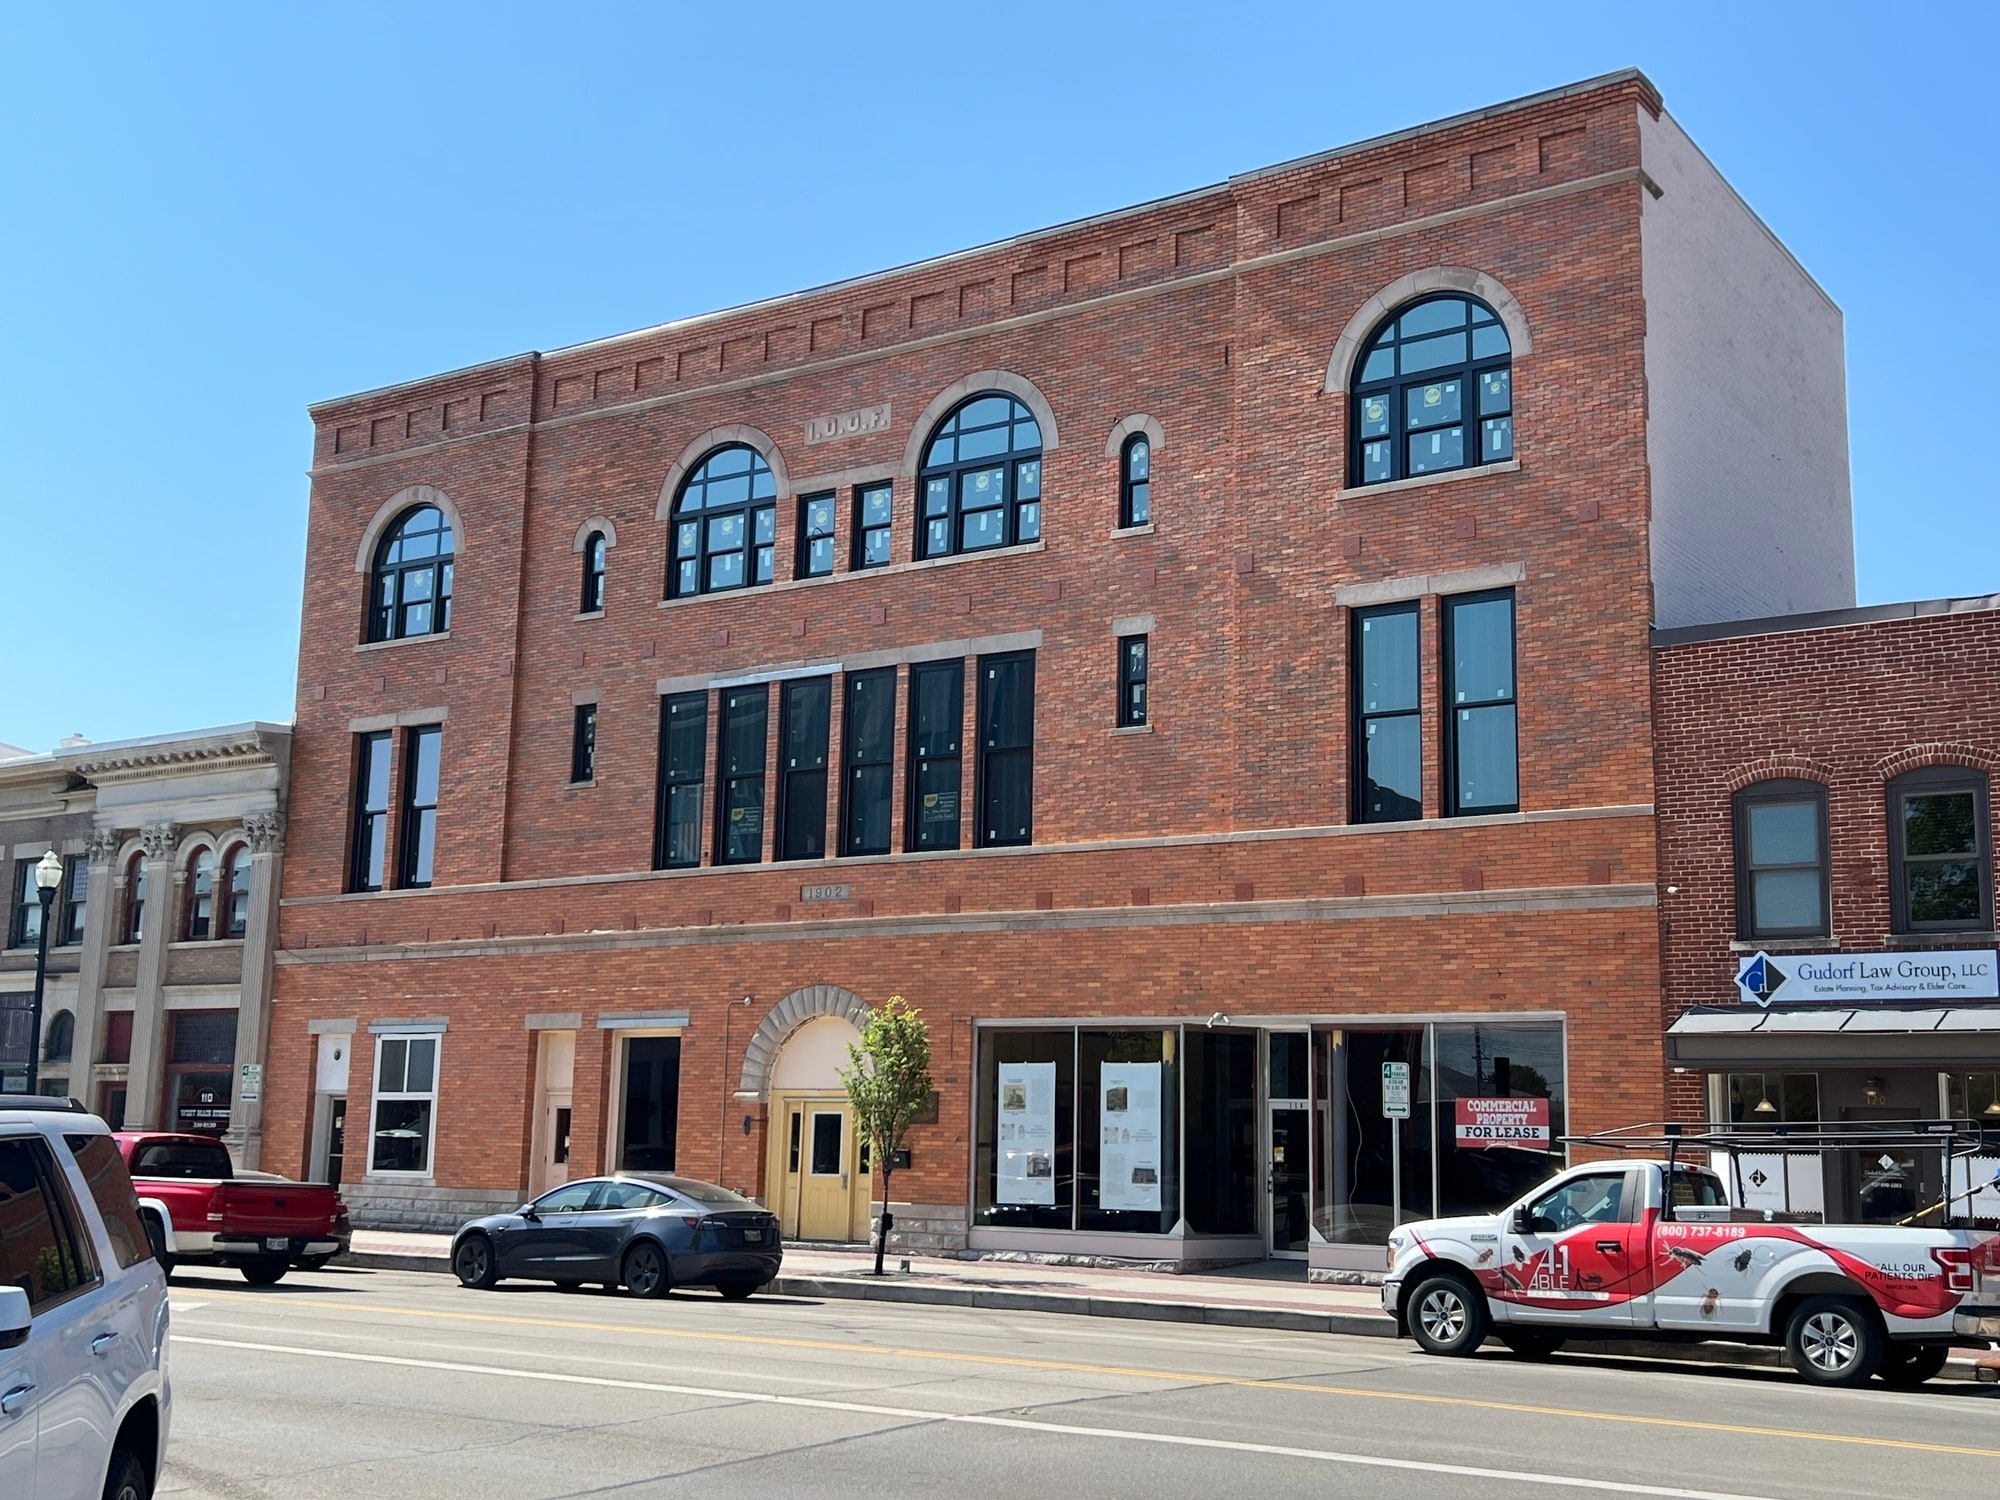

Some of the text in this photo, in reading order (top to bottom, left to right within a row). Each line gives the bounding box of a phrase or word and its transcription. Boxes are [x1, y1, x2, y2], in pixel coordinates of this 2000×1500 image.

[808, 886, 842, 899] 1902
[1798, 960, 1988, 981] Gudorf Law Group, LLC
[1871, 983, 1884, 991] Tax
[1885, 983, 1917, 992] Advisory
[1927, 982, 1945, 990] Elder
[1384, 1065, 1391, 1077] 4
[1467, 1100, 1537, 1112] COMMERCIAL
[1866, 1096, 1886, 1105] 120
[1476, 1114, 1528, 1125] PROPERTY
[1465, 1126, 1540, 1139] FOR LEASE
[1657, 1226, 1745, 1239] (800) 737-8189
[1903, 1263, 1925, 1272] OUR
[1865, 1271, 1914, 1281] PATIENTS
[1528, 1274, 1569, 1291] ABLE
